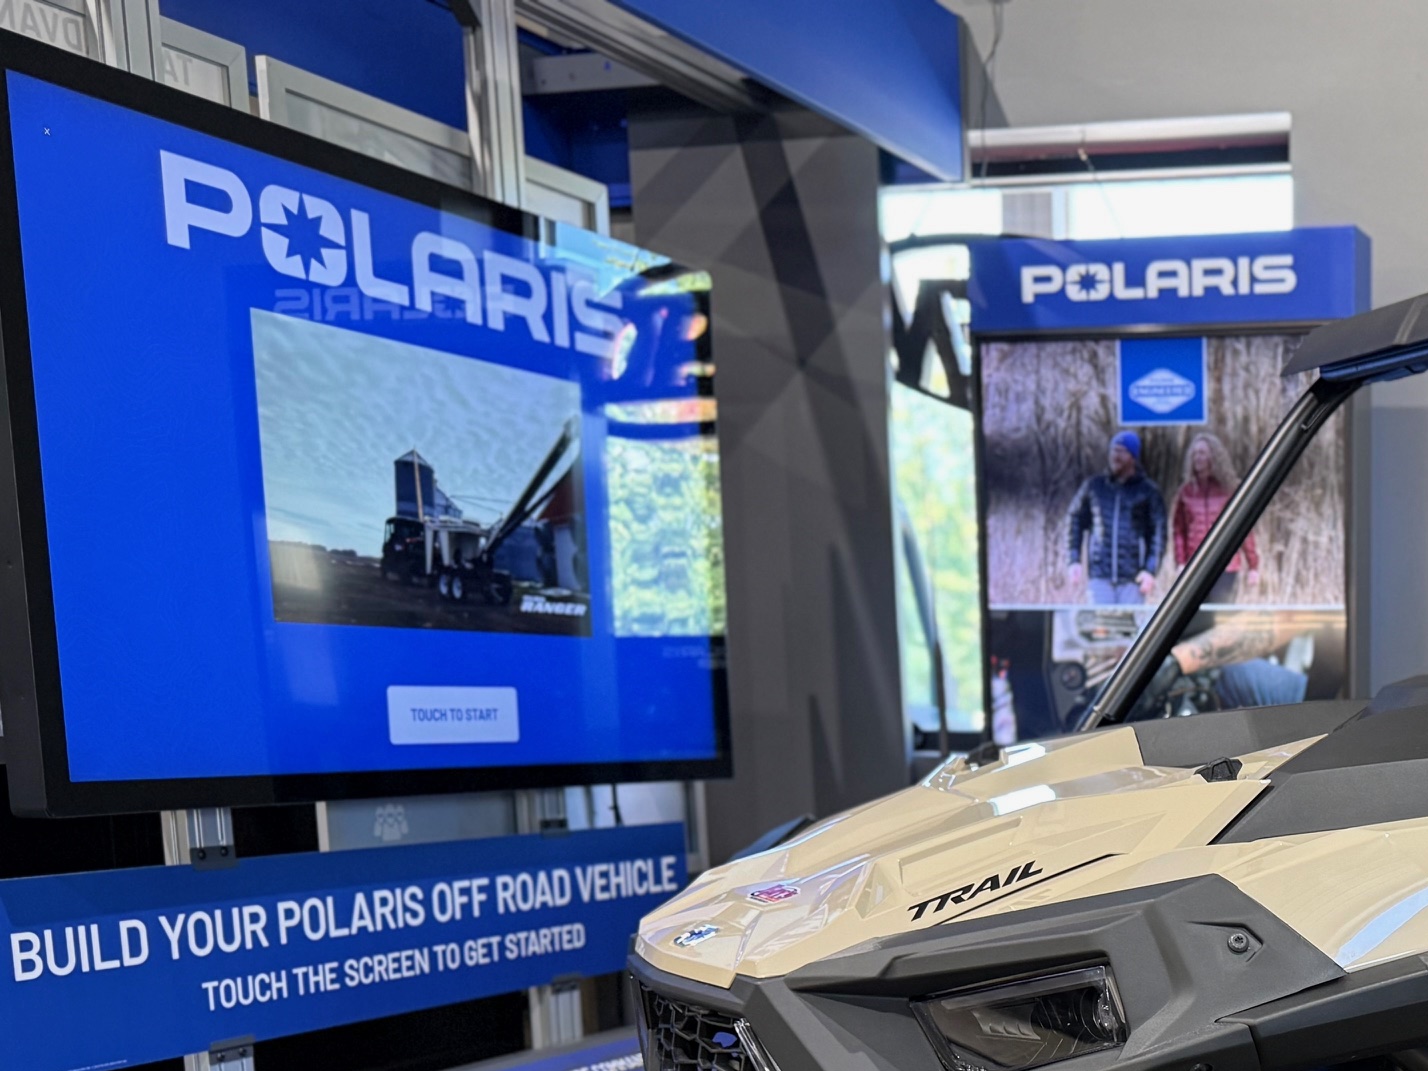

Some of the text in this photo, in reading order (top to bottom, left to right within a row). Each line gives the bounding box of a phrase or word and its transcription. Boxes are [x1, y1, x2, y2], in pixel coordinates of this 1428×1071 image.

[160, 149, 625, 361] POLARIS
[1021, 254, 1297, 304] POLARIS
[520, 600, 587, 617] RANGER
[410, 708, 498, 722] TOUCH TO START
[10, 855, 679, 982] BUILD YOUR POLARIS OFF ROAD VEHICLE
[907, 860, 1043, 922] TRAIL
[201, 923, 585, 1011] TOUCH THE SCREEN TO GET STARTED
